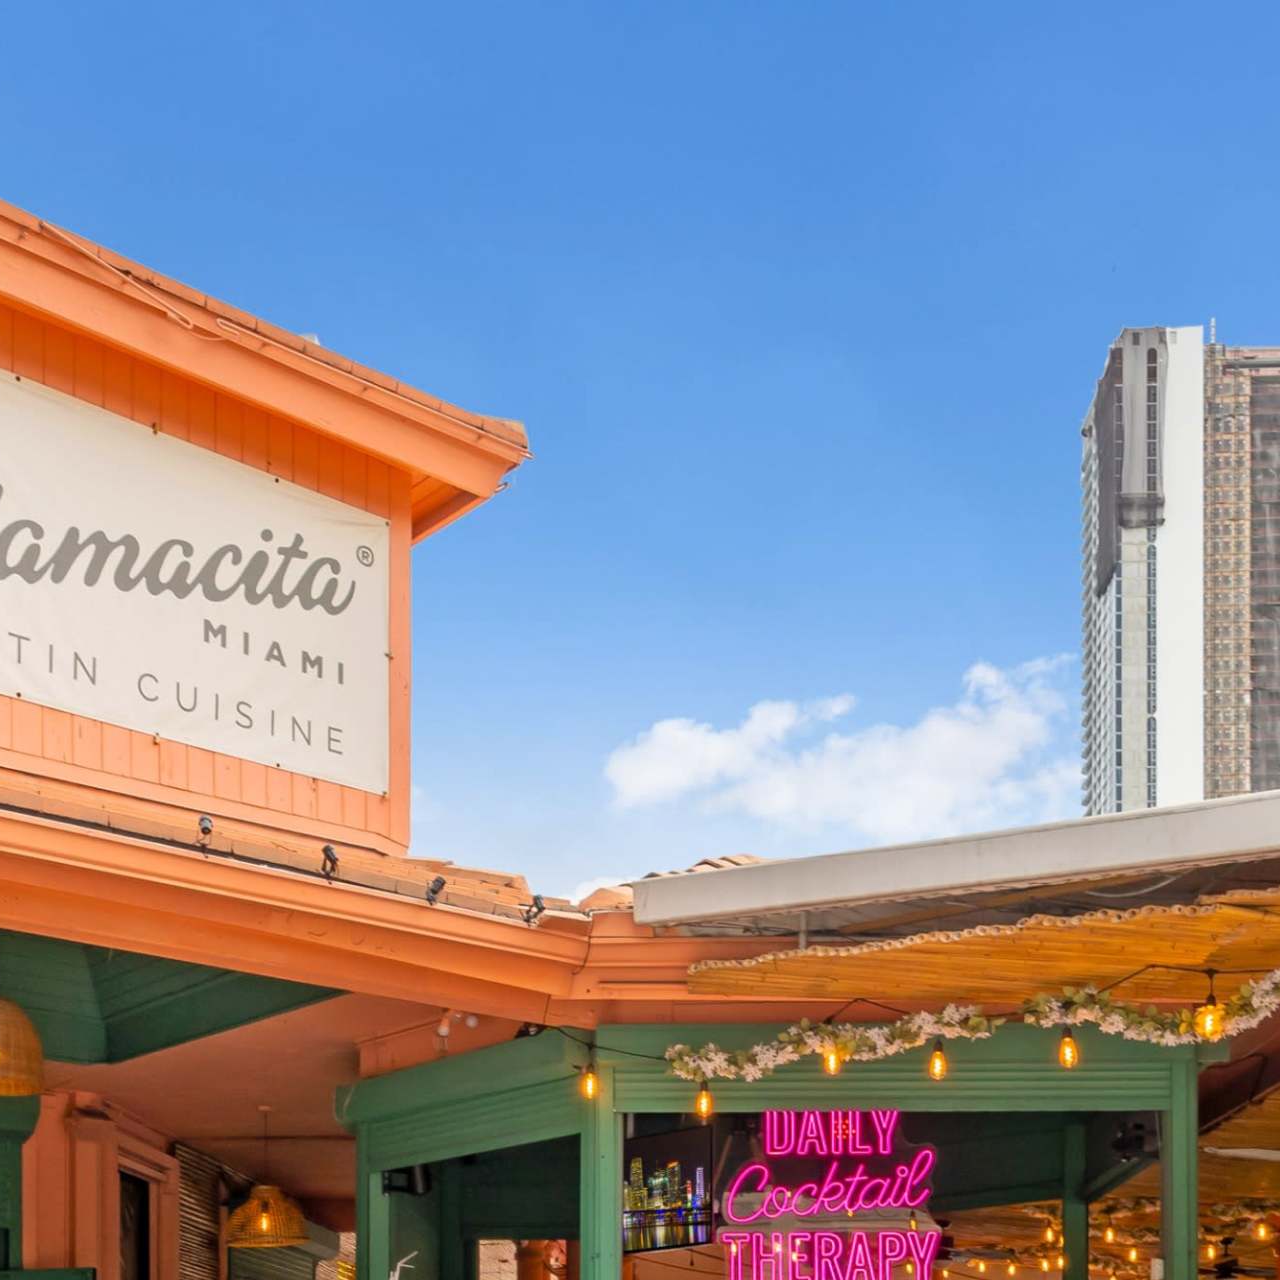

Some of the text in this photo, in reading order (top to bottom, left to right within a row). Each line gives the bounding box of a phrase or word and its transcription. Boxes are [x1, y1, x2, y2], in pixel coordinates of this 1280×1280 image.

[203, 618, 345, 685] MIAMI
[137, 673, 344, 756] CUISINE
[763, 1109, 900, 1156] DAILY
[726, 1148, 936, 1224] Cocktail
